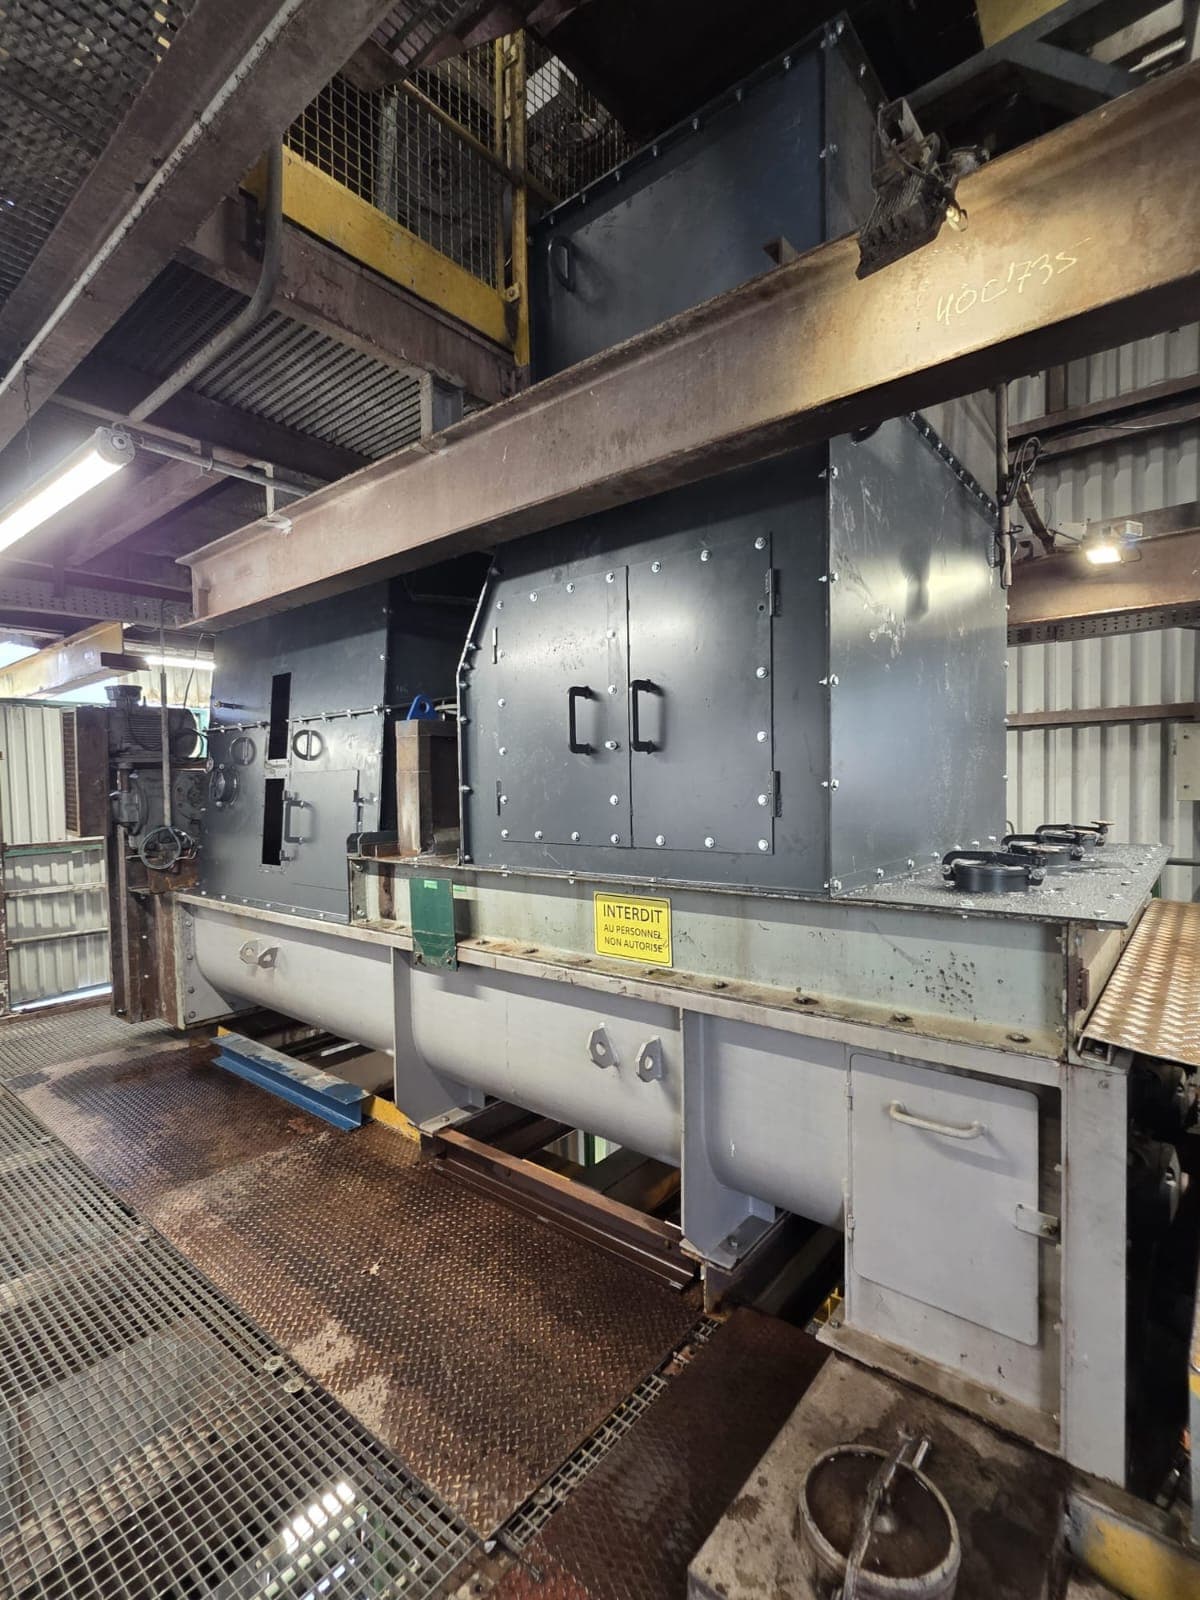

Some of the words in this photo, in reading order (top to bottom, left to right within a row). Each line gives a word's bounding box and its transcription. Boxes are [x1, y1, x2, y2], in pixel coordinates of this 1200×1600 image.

[603, 904, 663, 923] INTERDIT
[604, 924, 614, 933] AU
[616, 926, 663, 939] PERSONNEL
[604, 936, 622, 946] NON
